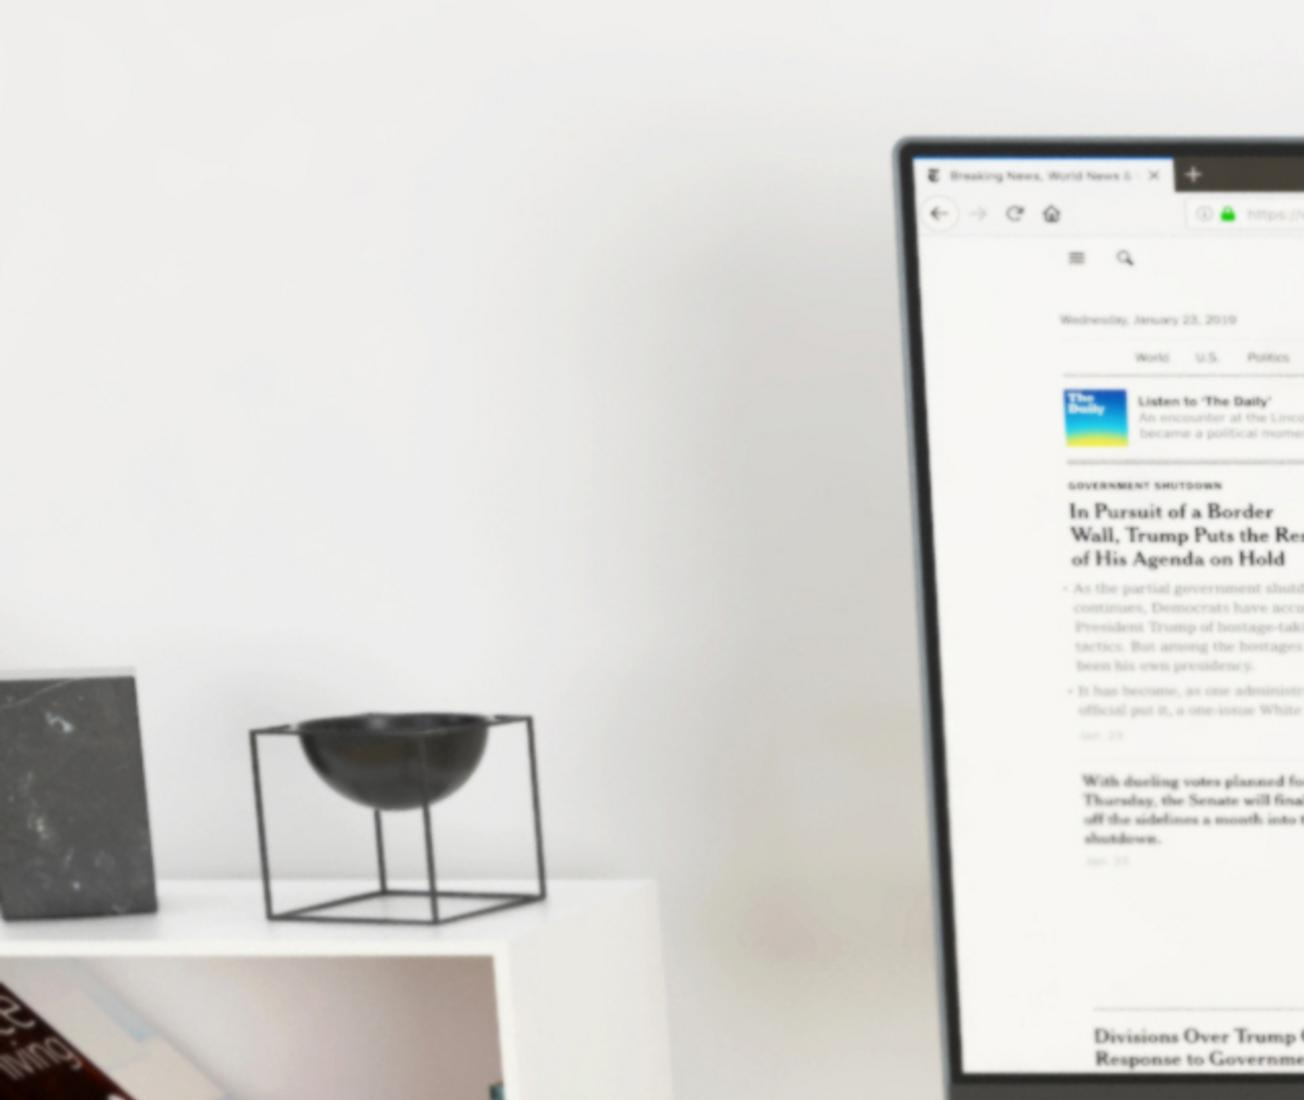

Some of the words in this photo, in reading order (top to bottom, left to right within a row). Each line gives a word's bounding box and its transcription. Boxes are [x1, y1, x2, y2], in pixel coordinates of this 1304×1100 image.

[1068, 482, 1149, 490] GOVERNMENT
[1154, 482, 1222, 490] SHUTDOWN
[1069, 503, 1089, 519] In
[1094, 503, 1162, 519] Pursuit
[1168, 504, 1186, 519] of
[1207, 503, 1273, 519] Border
[1070, 526, 1119, 543] Wall,
[1126, 526, 1189, 546] Trump
[1194, 526, 1234, 543] Puts
[1239, 527, 1269, 542] the
[1072, 551, 1090, 566] of
[1095, 550, 1127, 566] His
[1134, 551, 1205, 569] Agenda
[1209, 556, 1234, 566] on
[1239, 550, 1285, 566] Hold
[1094, 1028, 1179, 1044] Divisions
[1183, 1028, 1229, 1043] Over
[1234, 1028, 1297, 1047] Trump
[1095, 1051, 1181, 1070] Response
[1186, 1054, 1205, 1066] to
